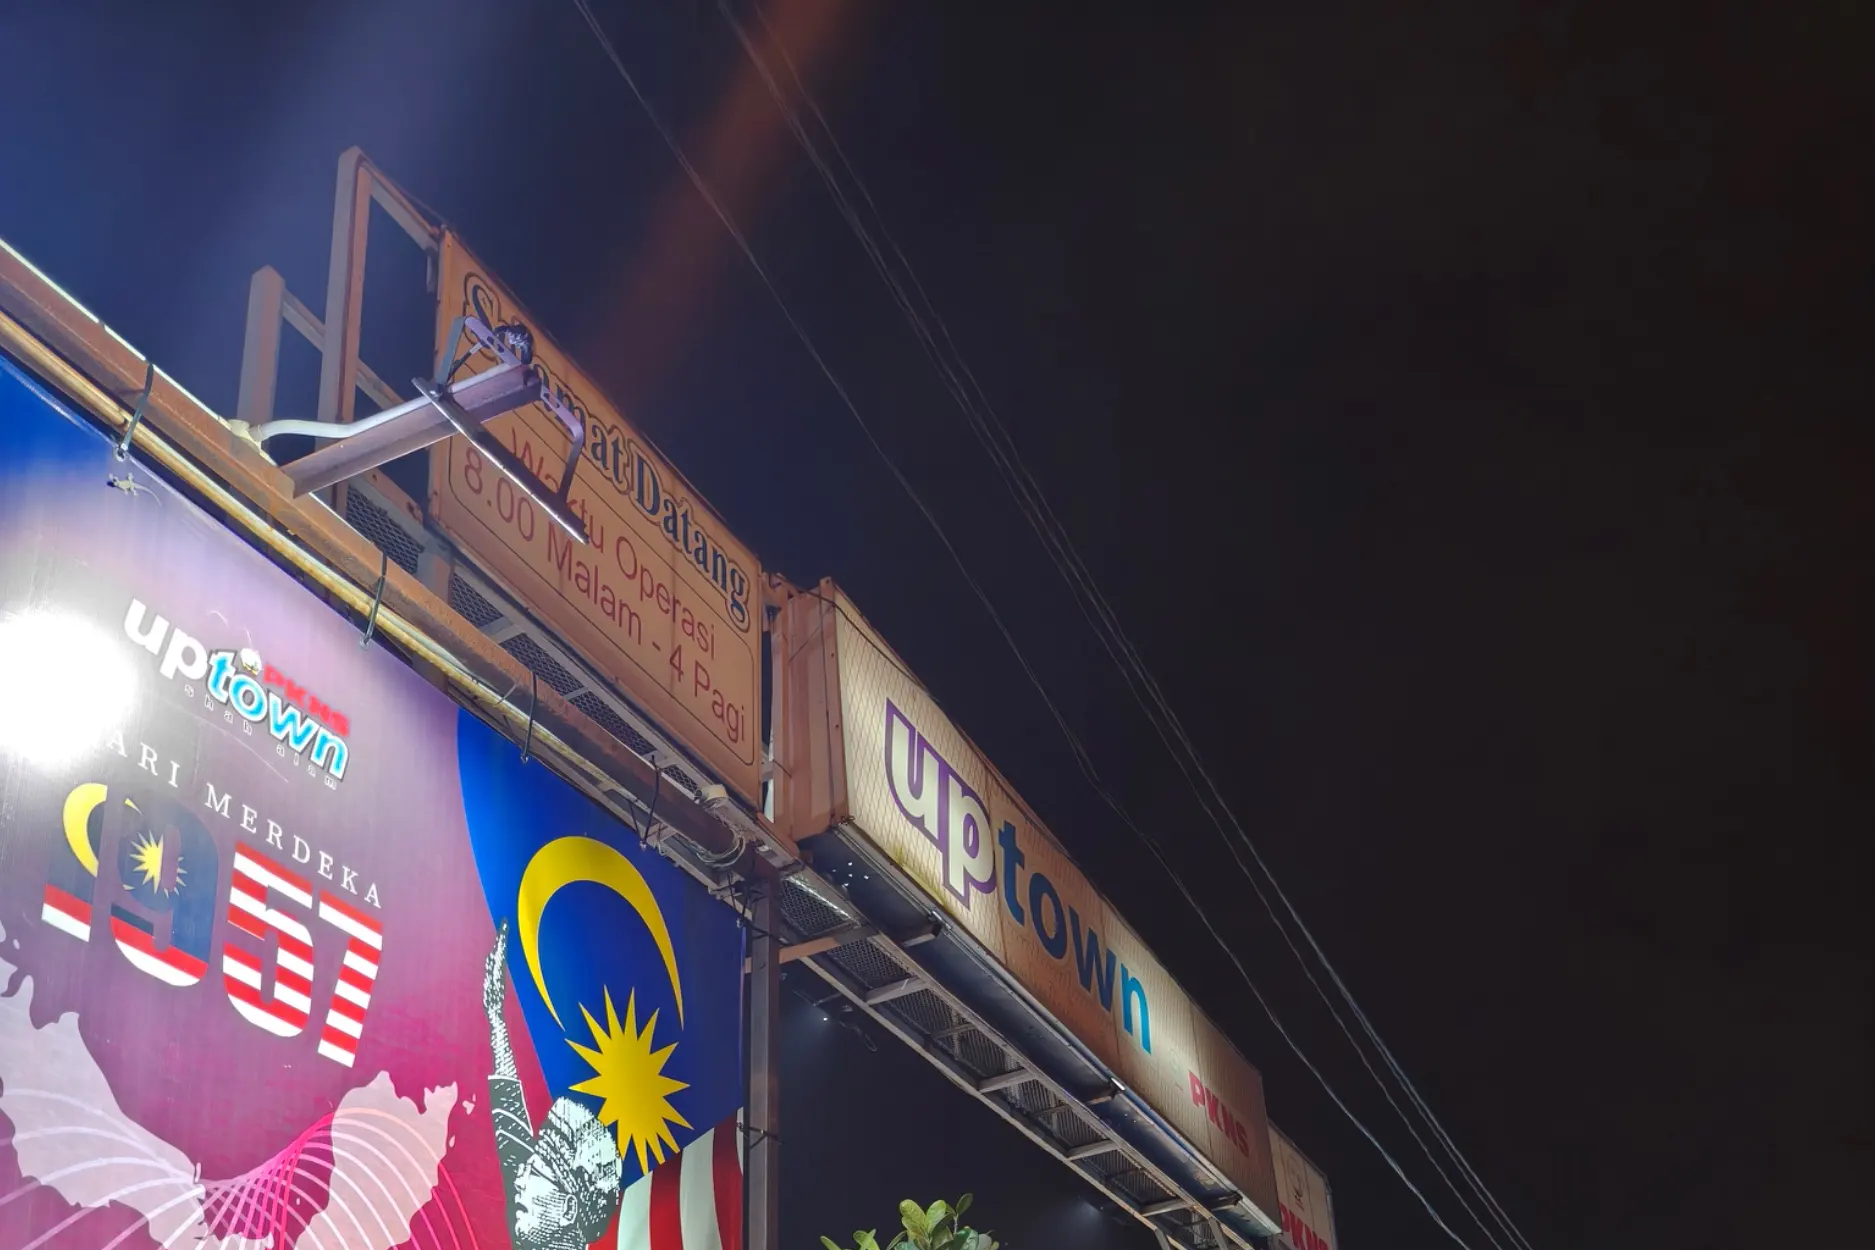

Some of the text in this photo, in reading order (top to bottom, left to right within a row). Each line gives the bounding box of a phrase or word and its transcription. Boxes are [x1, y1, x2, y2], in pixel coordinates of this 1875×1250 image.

[464, 446, 535, 542] 8.00
[547, 519, 642, 645] Malam
[669, 647, 684, 684] 4
[694, 672, 746, 744] Pagi
[616, 536, 715, 660] Operasi
[634, 456, 751, 628] Datang
[124, 598, 349, 781] uptown
[106, 729, 383, 910] ARI MERDEKA
[886, 697, 1152, 1055] uptown
[41, 783, 384, 1069] 1957
[1188, 1069, 1249, 1158] PKNS
